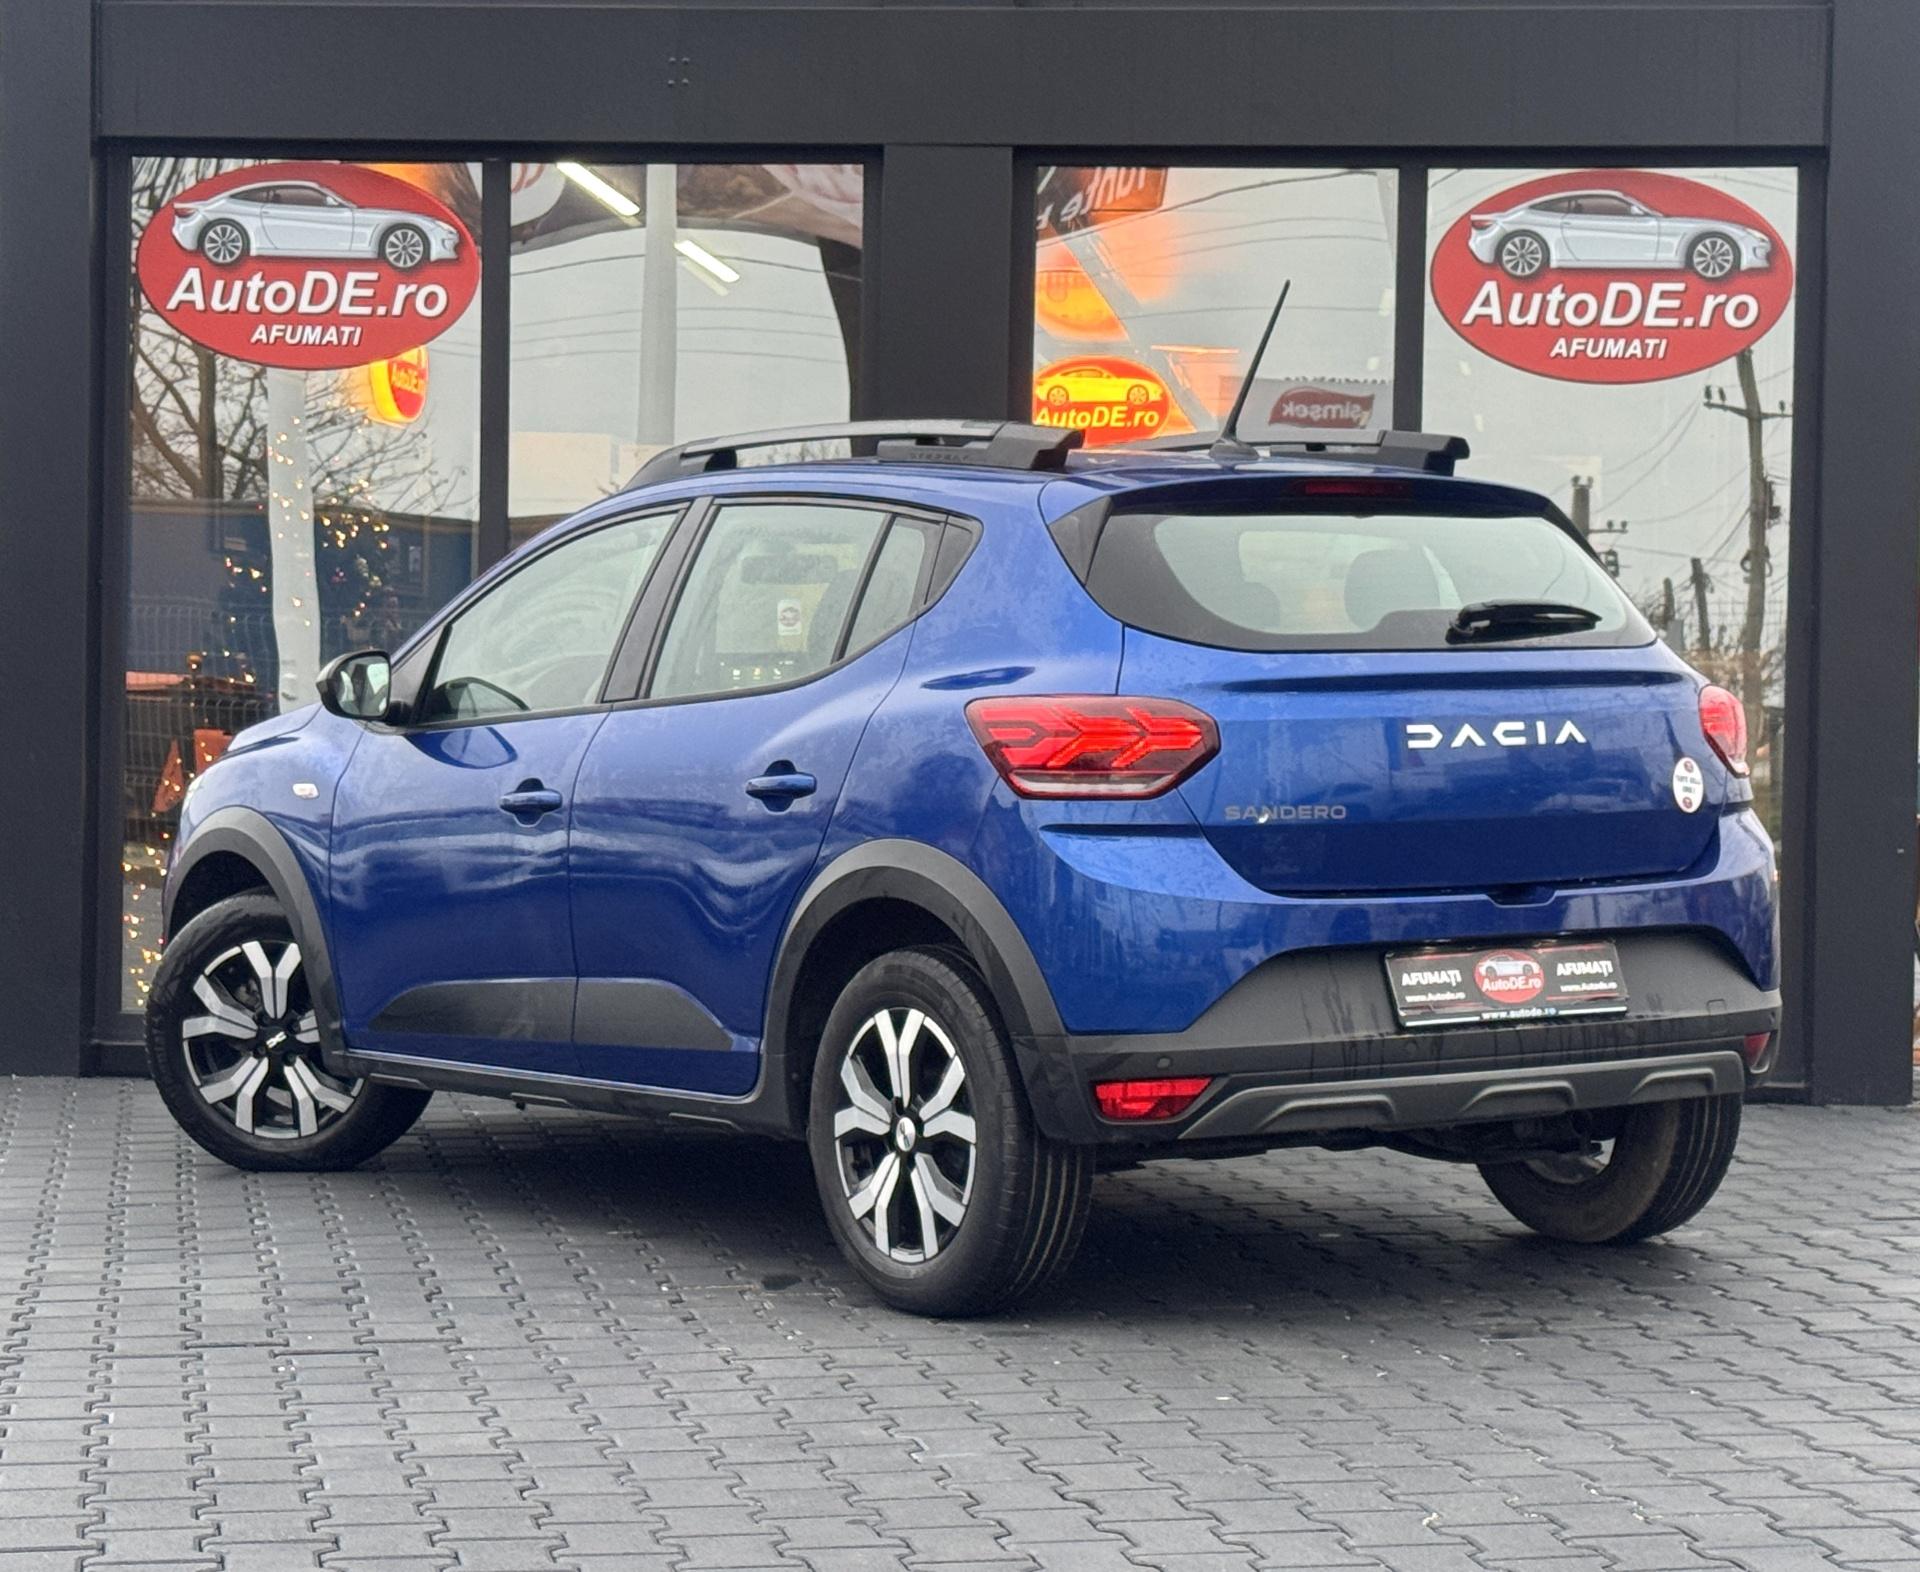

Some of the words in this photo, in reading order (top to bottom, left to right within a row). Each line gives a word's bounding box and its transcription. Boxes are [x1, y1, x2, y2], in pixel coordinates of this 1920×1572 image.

[167, 267, 448, 318] AutoDE.ro
[1462, 281, 1758, 328] AutoDE.ro
[251, 324, 361, 346] AFUMATI
[1551, 338, 1667, 359] AFUMATI
[1036, 405, 1160, 429] AutoDE.ro
[1406, 719, 1587, 749] DACIA
[1224, 804, 1347, 822] SANDERO
[1481, 976, 1542, 993] AutoDE.ro
